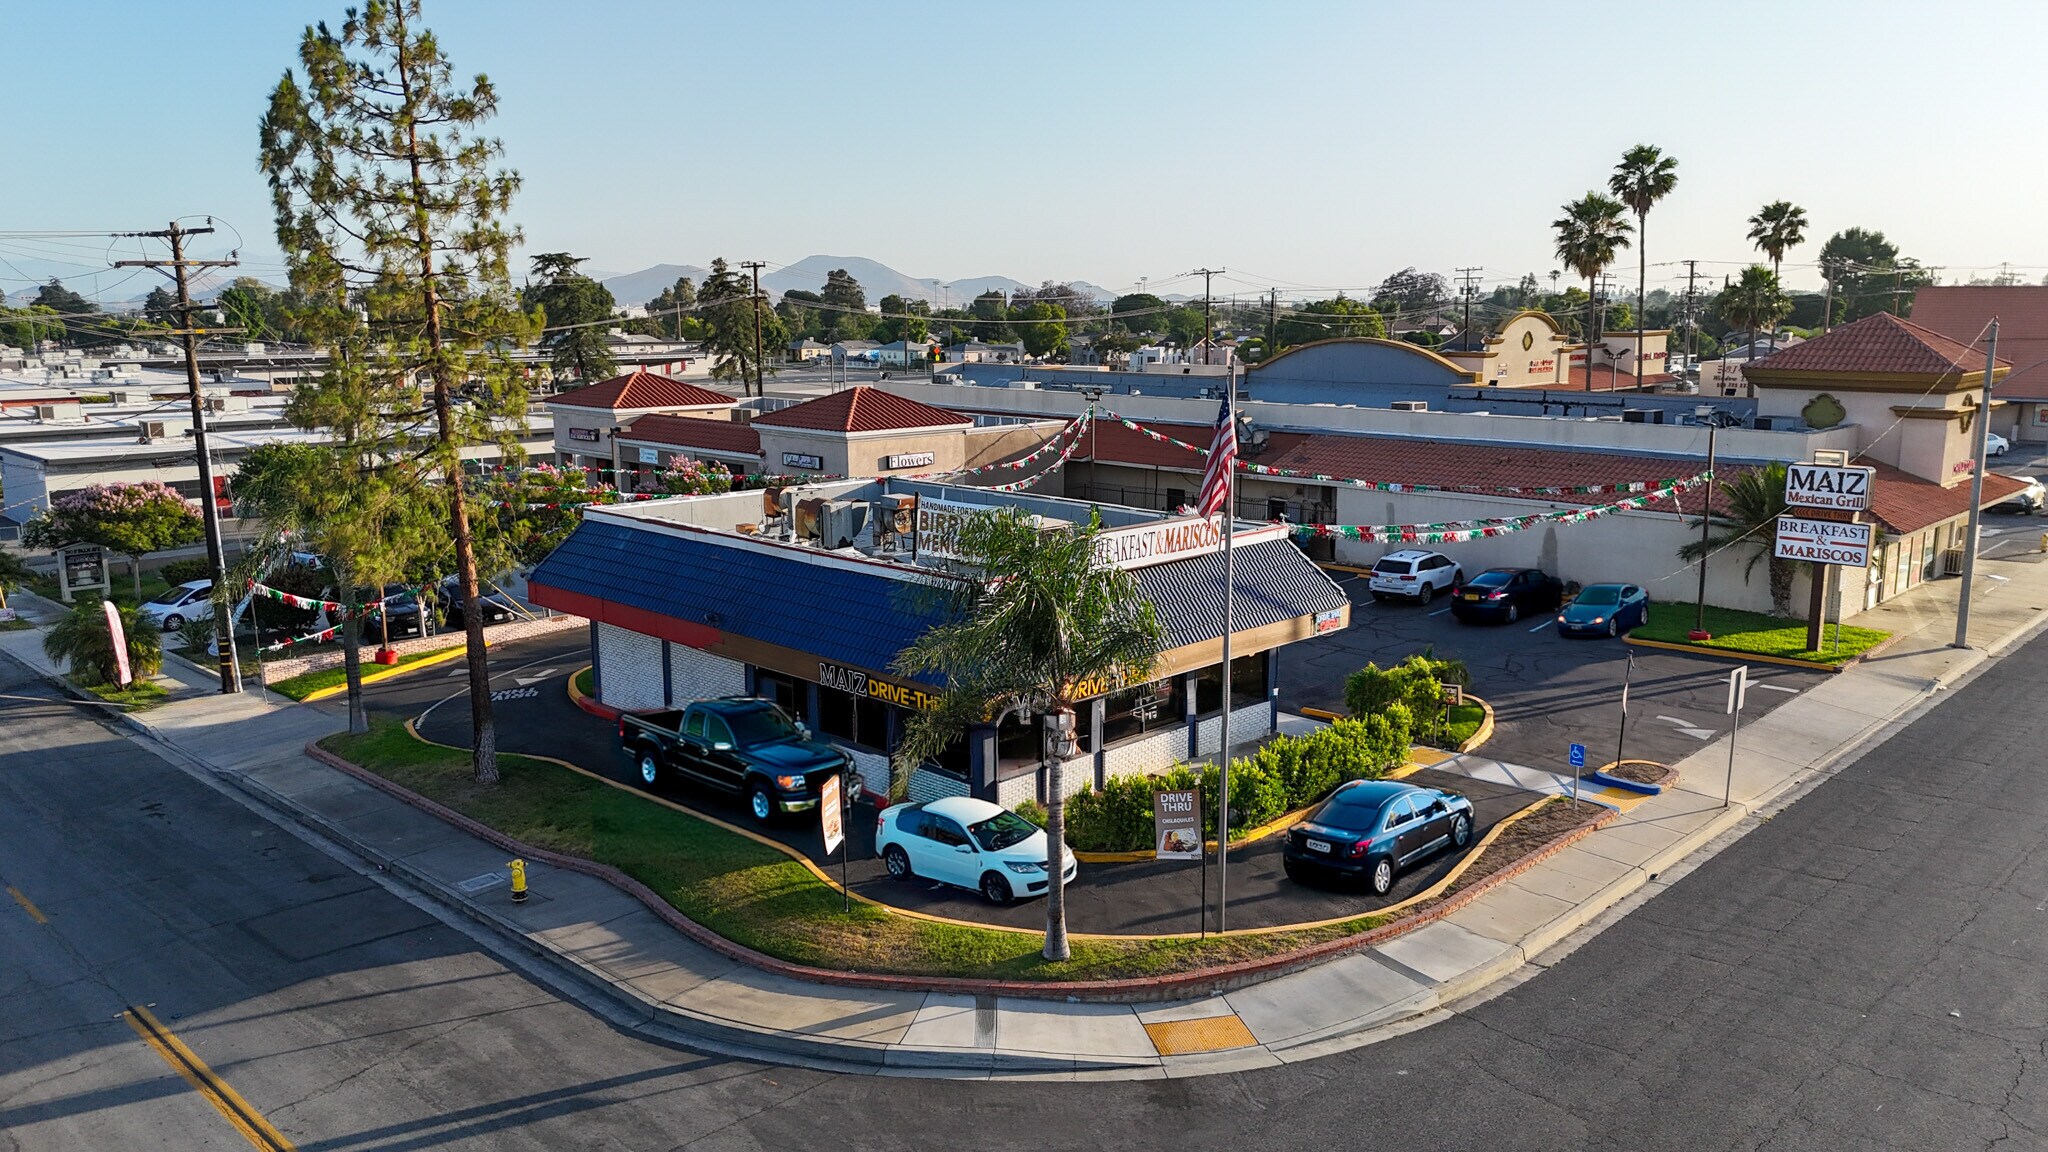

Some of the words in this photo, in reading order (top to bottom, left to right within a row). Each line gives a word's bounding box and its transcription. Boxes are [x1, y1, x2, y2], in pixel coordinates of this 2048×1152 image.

[889, 455, 933, 468] Flowers
[1789, 468, 1865, 495] MAIZ
[921, 500, 956, 513] HANDMADE
[1788, 491, 1833, 506] Mexican
[1836, 495, 1864, 508] Grill
[1811, 509, 1832, 518] DRIVE
[1155, 531, 1164, 555] &
[1163, 520, 1220, 555] MARISCOS
[1780, 521, 1869, 540] BREAKFAST
[1815, 535, 1828, 546] &
[1780, 544, 1862, 564] MARISCOS
[819, 663, 867, 697] MAIZ
[1160, 793, 1193, 803] DRIVE
[1162, 802, 1192, 812] THRU
